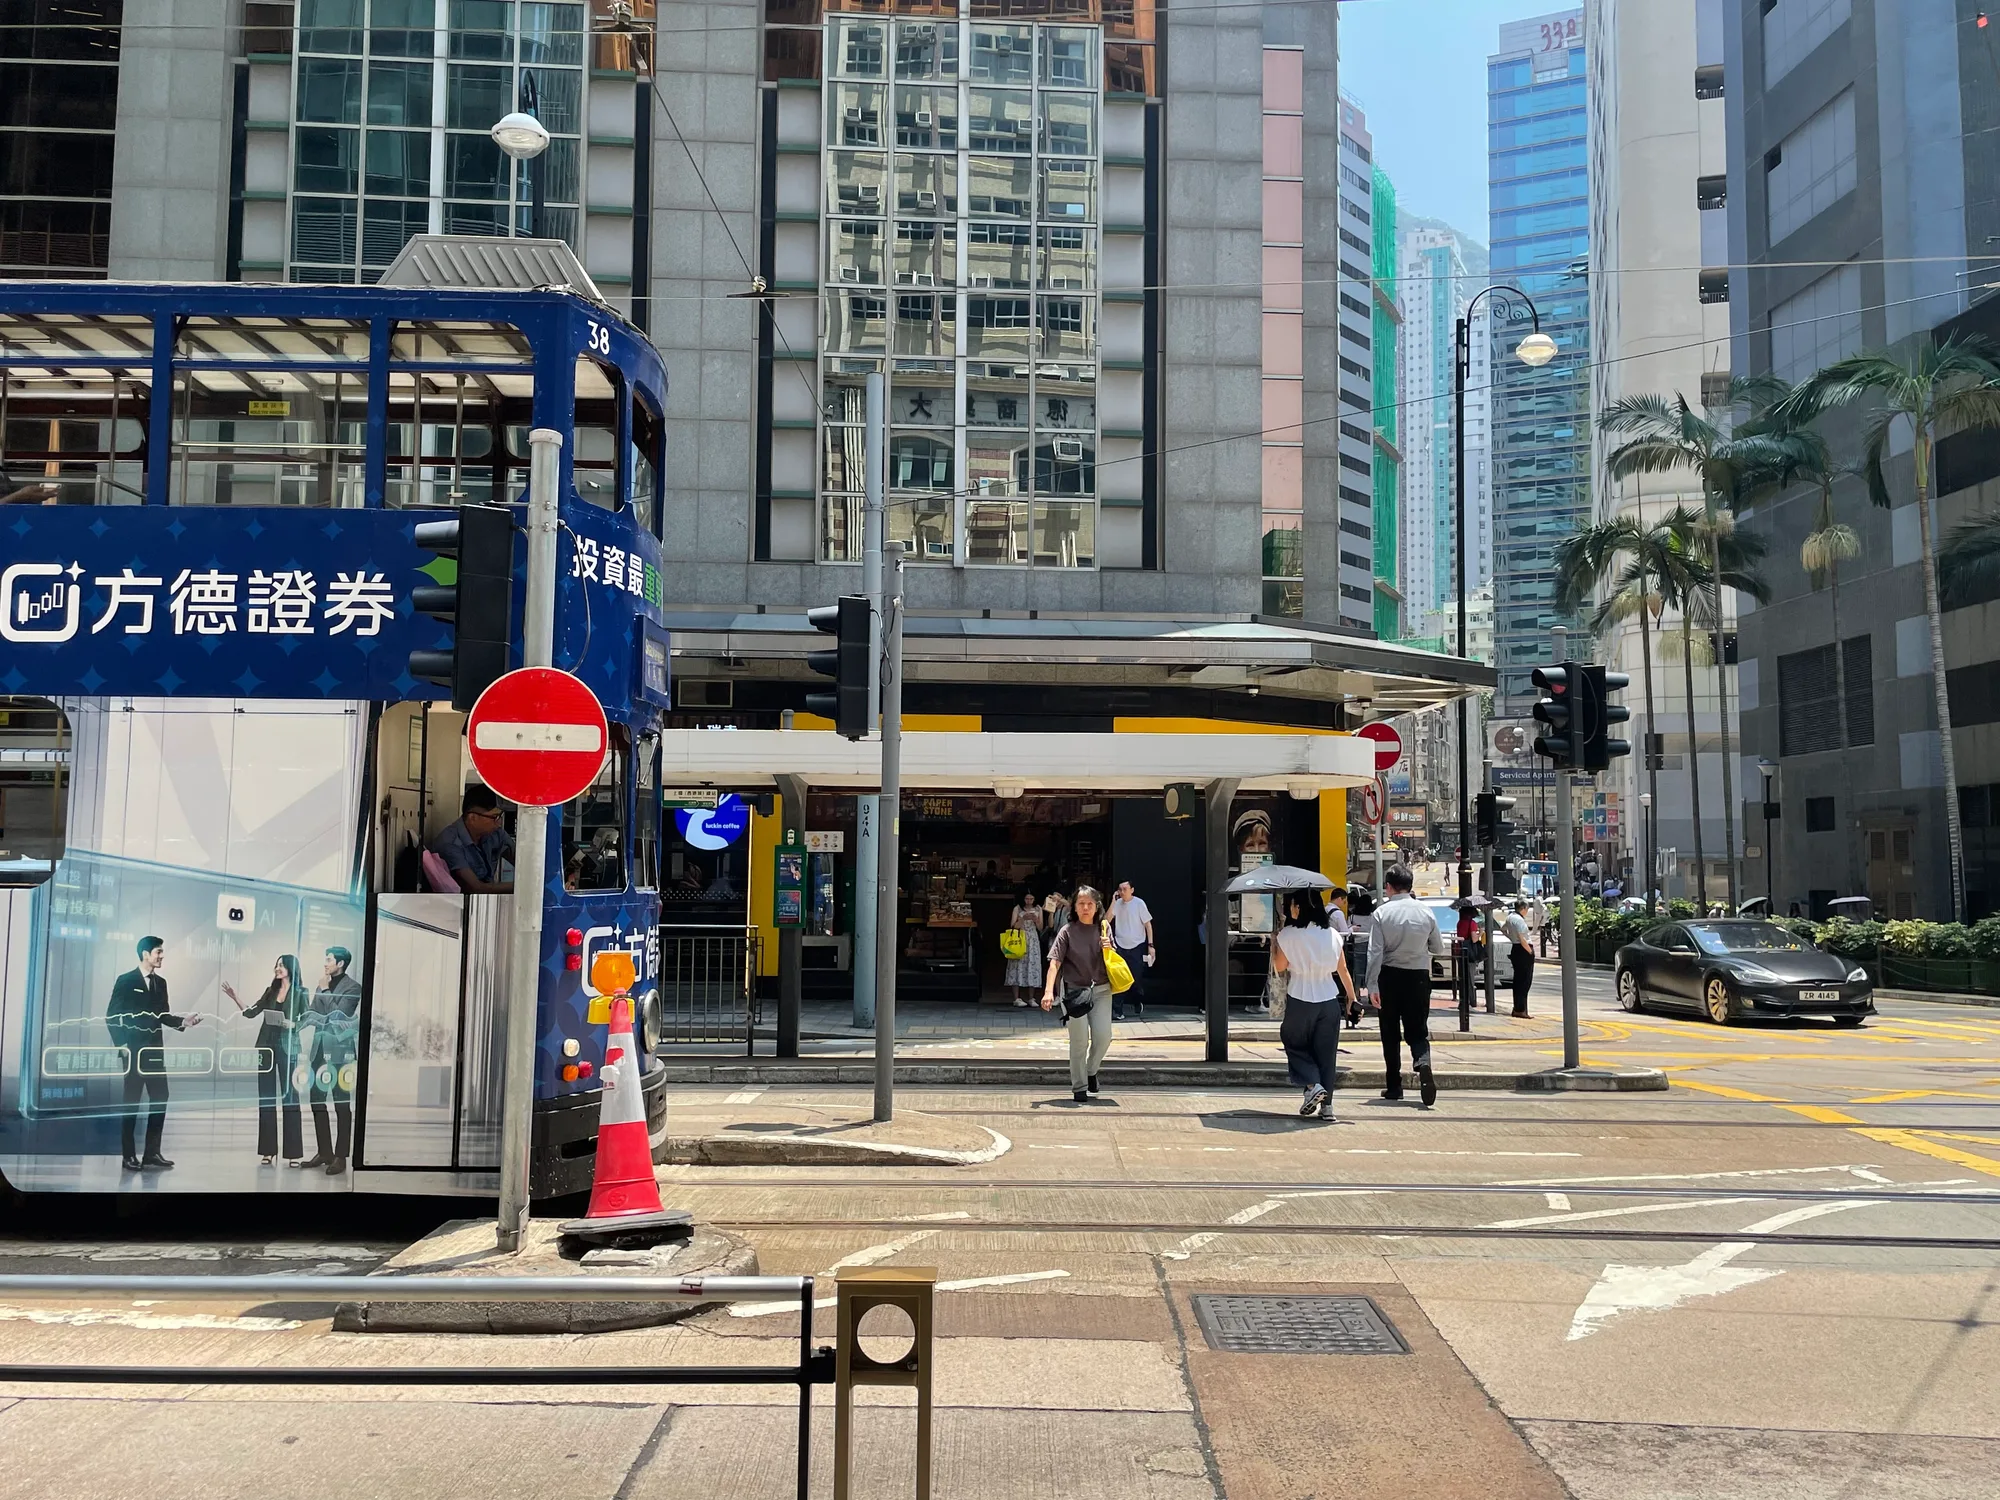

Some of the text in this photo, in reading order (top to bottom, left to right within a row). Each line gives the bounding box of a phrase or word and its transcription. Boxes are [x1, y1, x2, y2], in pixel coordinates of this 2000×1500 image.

[587, 319, 610, 355] 38
[91, 568, 395, 635] 方德證券
[1499, 771, 1531, 779] Serviced
[922, 798, 953, 807] PAPER
[922, 806, 953, 816] STONE
[705, 822, 740, 830] luckin coffee
[259, 910, 275, 927] AI
[1804, 992, 1836, 1000] ZR 4145
